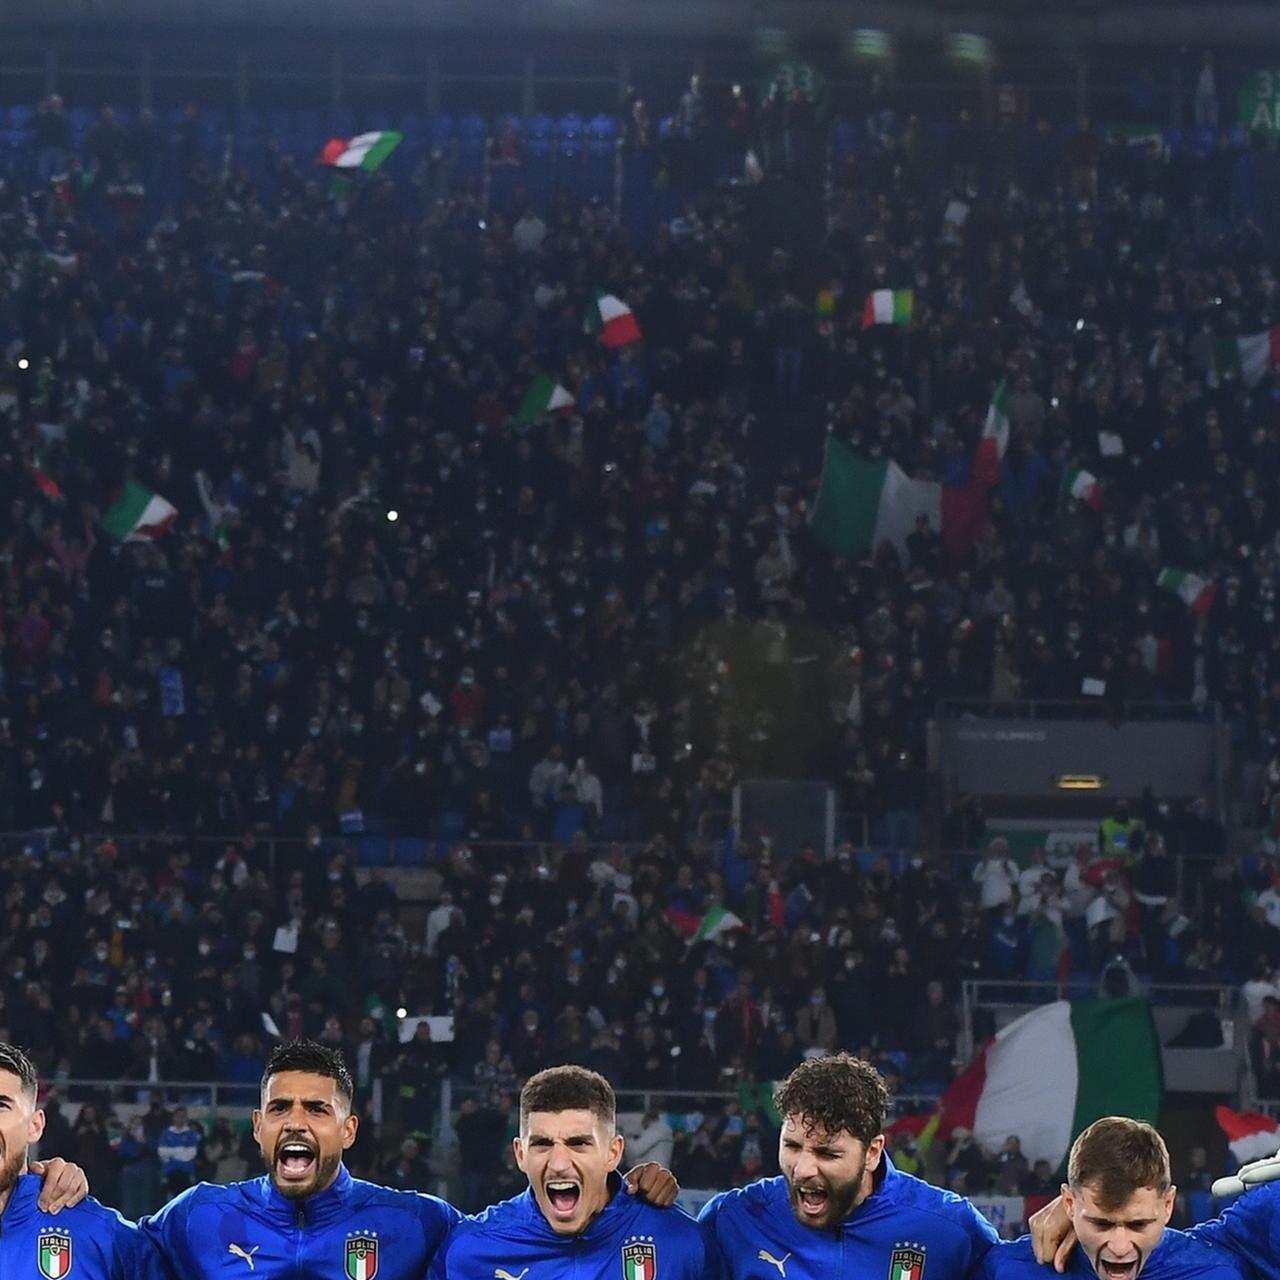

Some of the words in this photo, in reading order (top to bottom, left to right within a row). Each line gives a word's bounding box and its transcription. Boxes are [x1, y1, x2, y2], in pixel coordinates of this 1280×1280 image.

[41, 1237, 69, 1247] ITALIA
[348, 1241, 375, 1250] ITALIA
[625, 1247, 652, 1256] ITALIA
[894, 1252, 923, 1263] ITALIA
